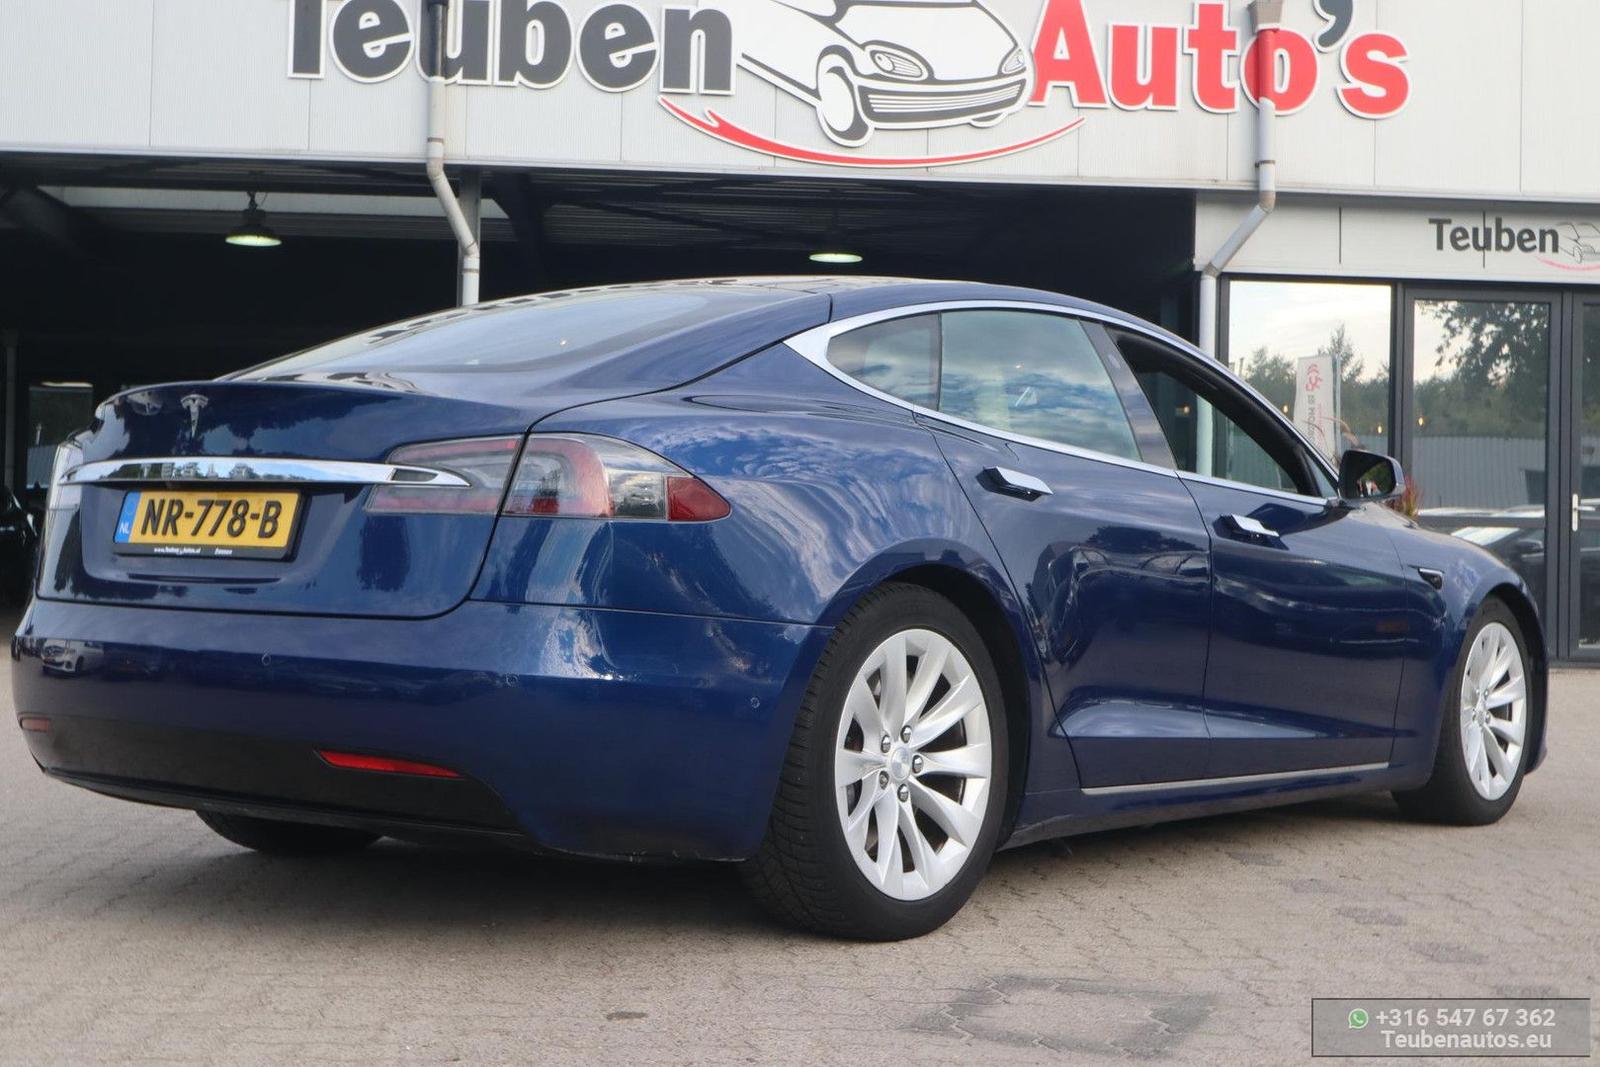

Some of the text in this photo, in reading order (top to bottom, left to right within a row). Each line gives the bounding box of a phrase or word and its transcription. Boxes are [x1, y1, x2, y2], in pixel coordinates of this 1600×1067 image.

[1031, 0, 1411, 118] Auto's
[1428, 216, 1560, 254] Teuben
[118, 522, 130, 534] NL
[140, 498, 283, 539] NR-778-B
